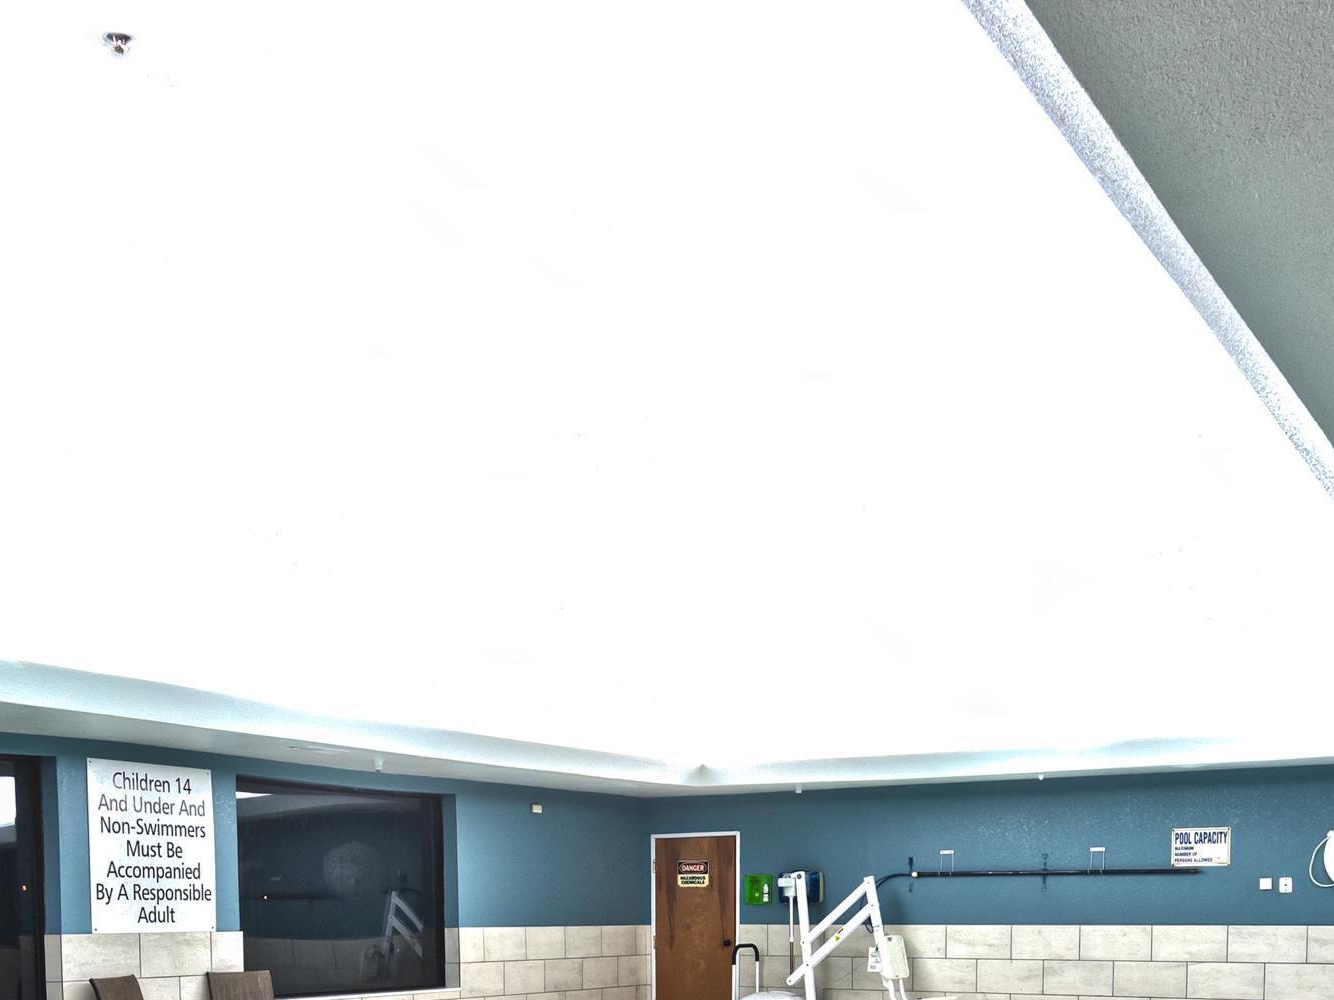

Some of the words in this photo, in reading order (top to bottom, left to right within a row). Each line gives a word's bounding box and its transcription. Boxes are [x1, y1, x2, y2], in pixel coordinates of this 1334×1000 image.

[112, 771, 171, 793] Children
[175, 777, 192, 795] 14
[98, 793, 128, 812] And
[133, 795, 175, 816] Under
[178, 799, 206, 817] And
[100, 815, 207, 838] Non-Swimmers
[126, 839, 162, 858] Must
[167, 841, 183, 859] Be
[1174, 832, 1193, 845] POOL
[1194, 831, 1228, 845] CAPACITY
[106, 860, 201, 883] Accompanied
[681, 864, 705, 872] DANGER
[96, 883, 114, 905] By
[117, 883, 129, 901] A
[133, 883, 212, 905] Responsible
[137, 905, 176, 924] Adult
